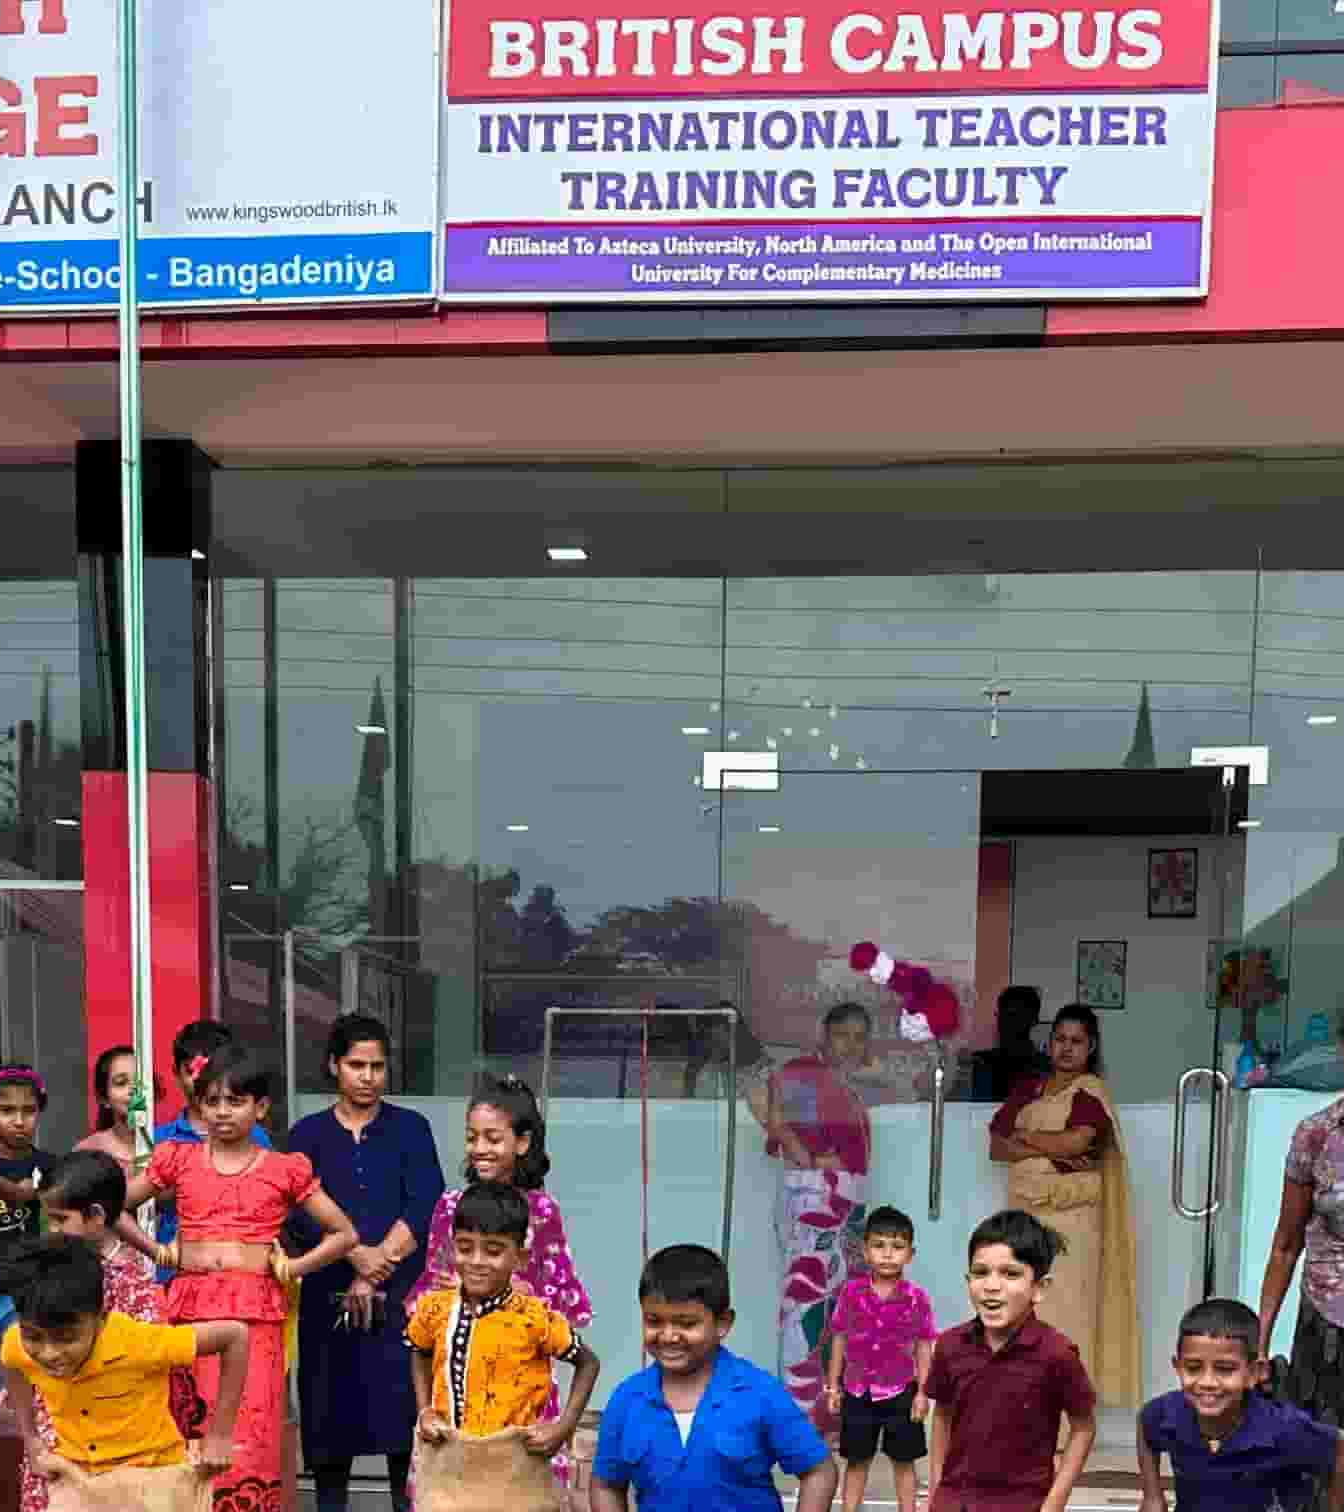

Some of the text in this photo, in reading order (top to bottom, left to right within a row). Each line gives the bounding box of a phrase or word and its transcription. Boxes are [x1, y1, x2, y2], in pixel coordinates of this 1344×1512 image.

[488, 10, 1163, 78] BRITISH CAMPUS
[477, 106, 1168, 153] INTERNATIONAL TEACHER
[560, 166, 1069, 212] TRAINING FACULTY
[186, 199, 399, 224] www.kingswoodbritish.lk
[487, 231, 1153, 258] Affiliated To Azteca University, North America and The Open International
[167, 253, 396, 294] Bangadeniya
[631, 260, 1003, 285] University For Complementary Medicines
